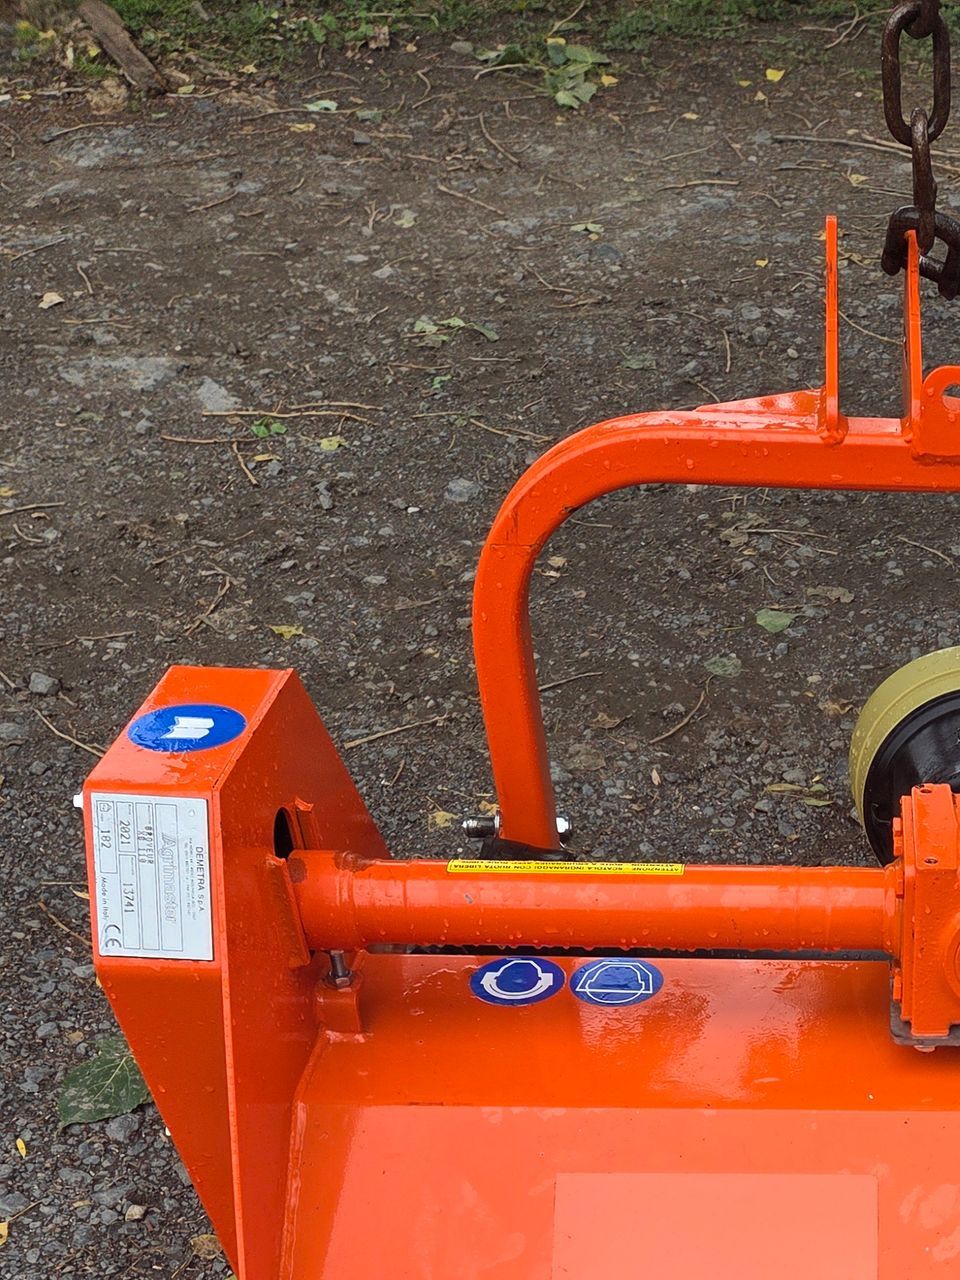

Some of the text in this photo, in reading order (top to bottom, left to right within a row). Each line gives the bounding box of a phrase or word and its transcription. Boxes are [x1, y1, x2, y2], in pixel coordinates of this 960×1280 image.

[101, 829, 110, 849] 182
[120, 820, 130, 845] 2021
[196, 846, 205, 891] DEMETRA
[123, 882, 134, 913] 13741
[101, 906, 109, 920] Italy
